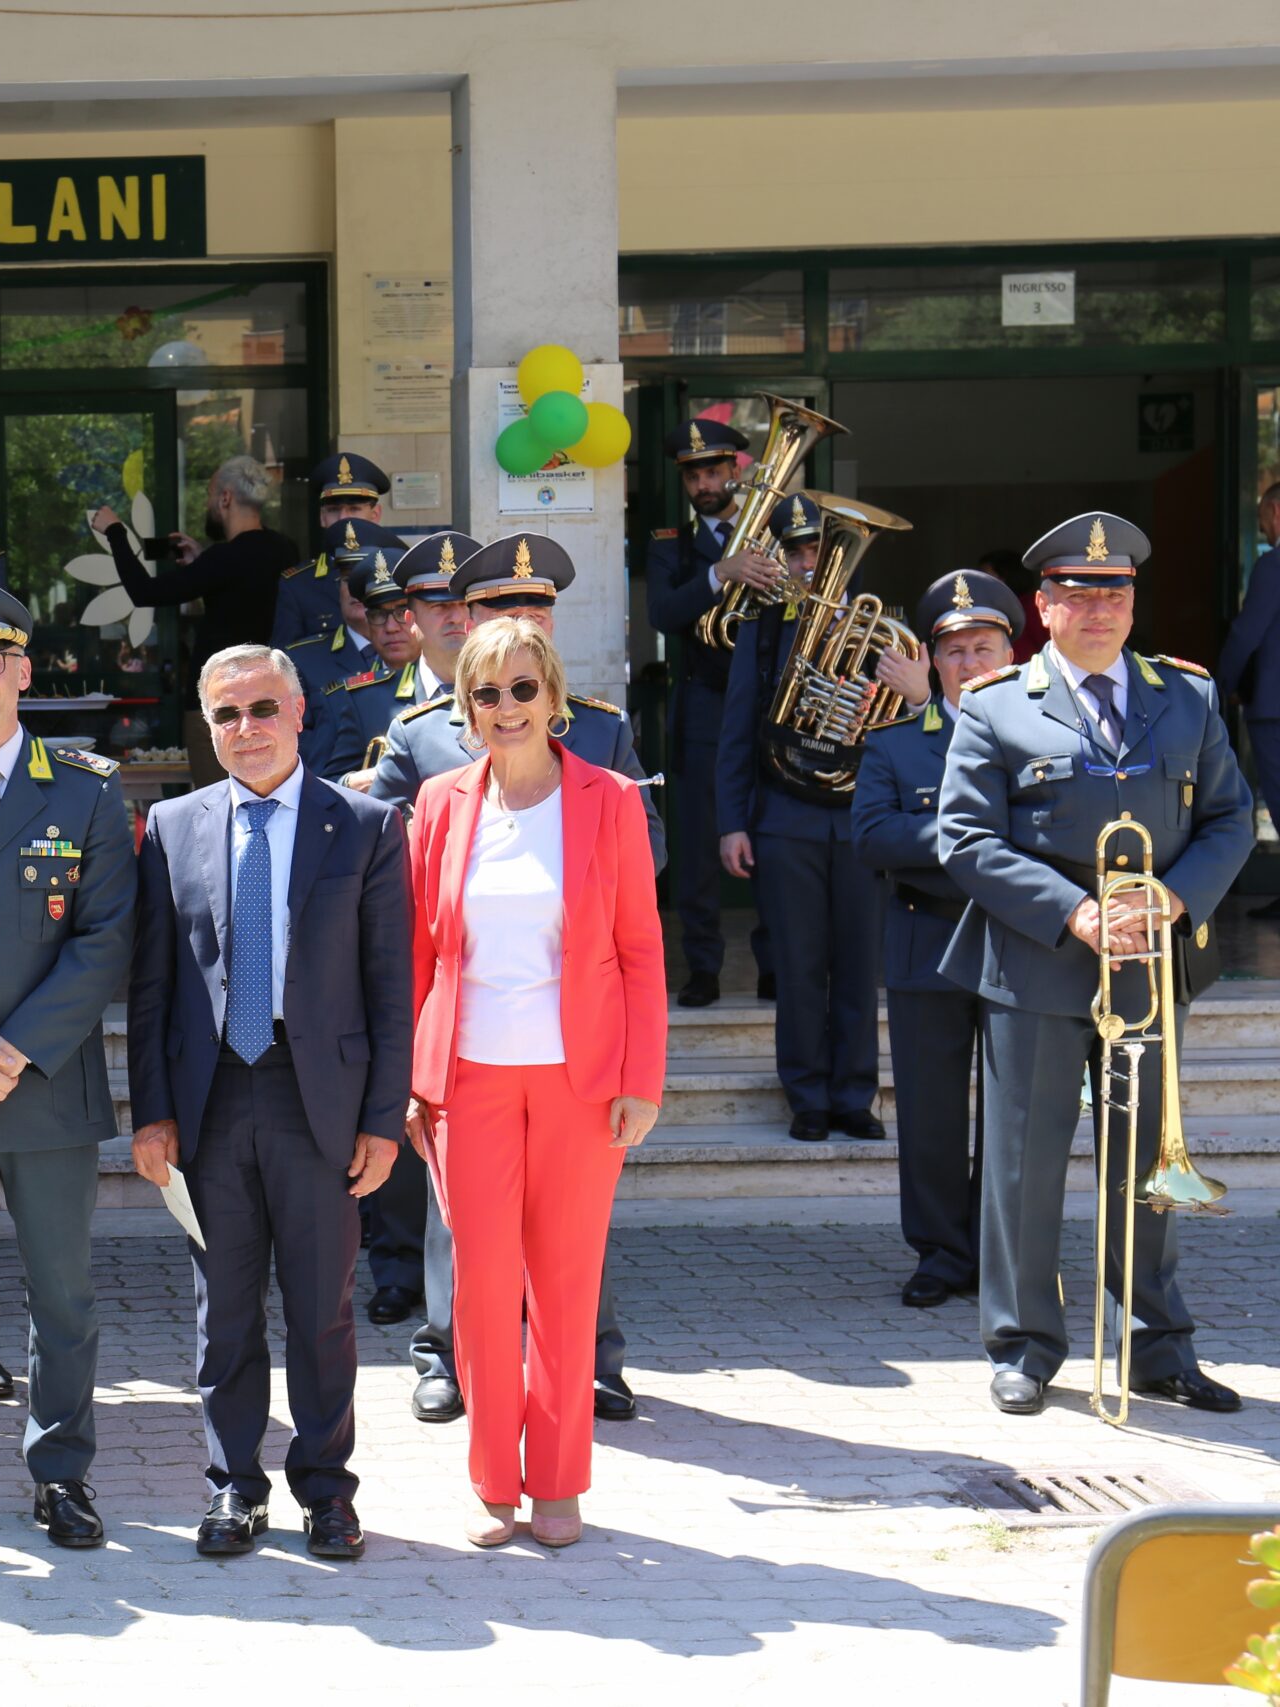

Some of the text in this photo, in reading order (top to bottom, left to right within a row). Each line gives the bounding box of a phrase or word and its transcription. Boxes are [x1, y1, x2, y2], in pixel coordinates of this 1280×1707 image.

[1009, 282, 1067, 294] INGRESSO
[1033, 301, 1042, 314] 3
[801, 737, 836, 754] YAMAHA
